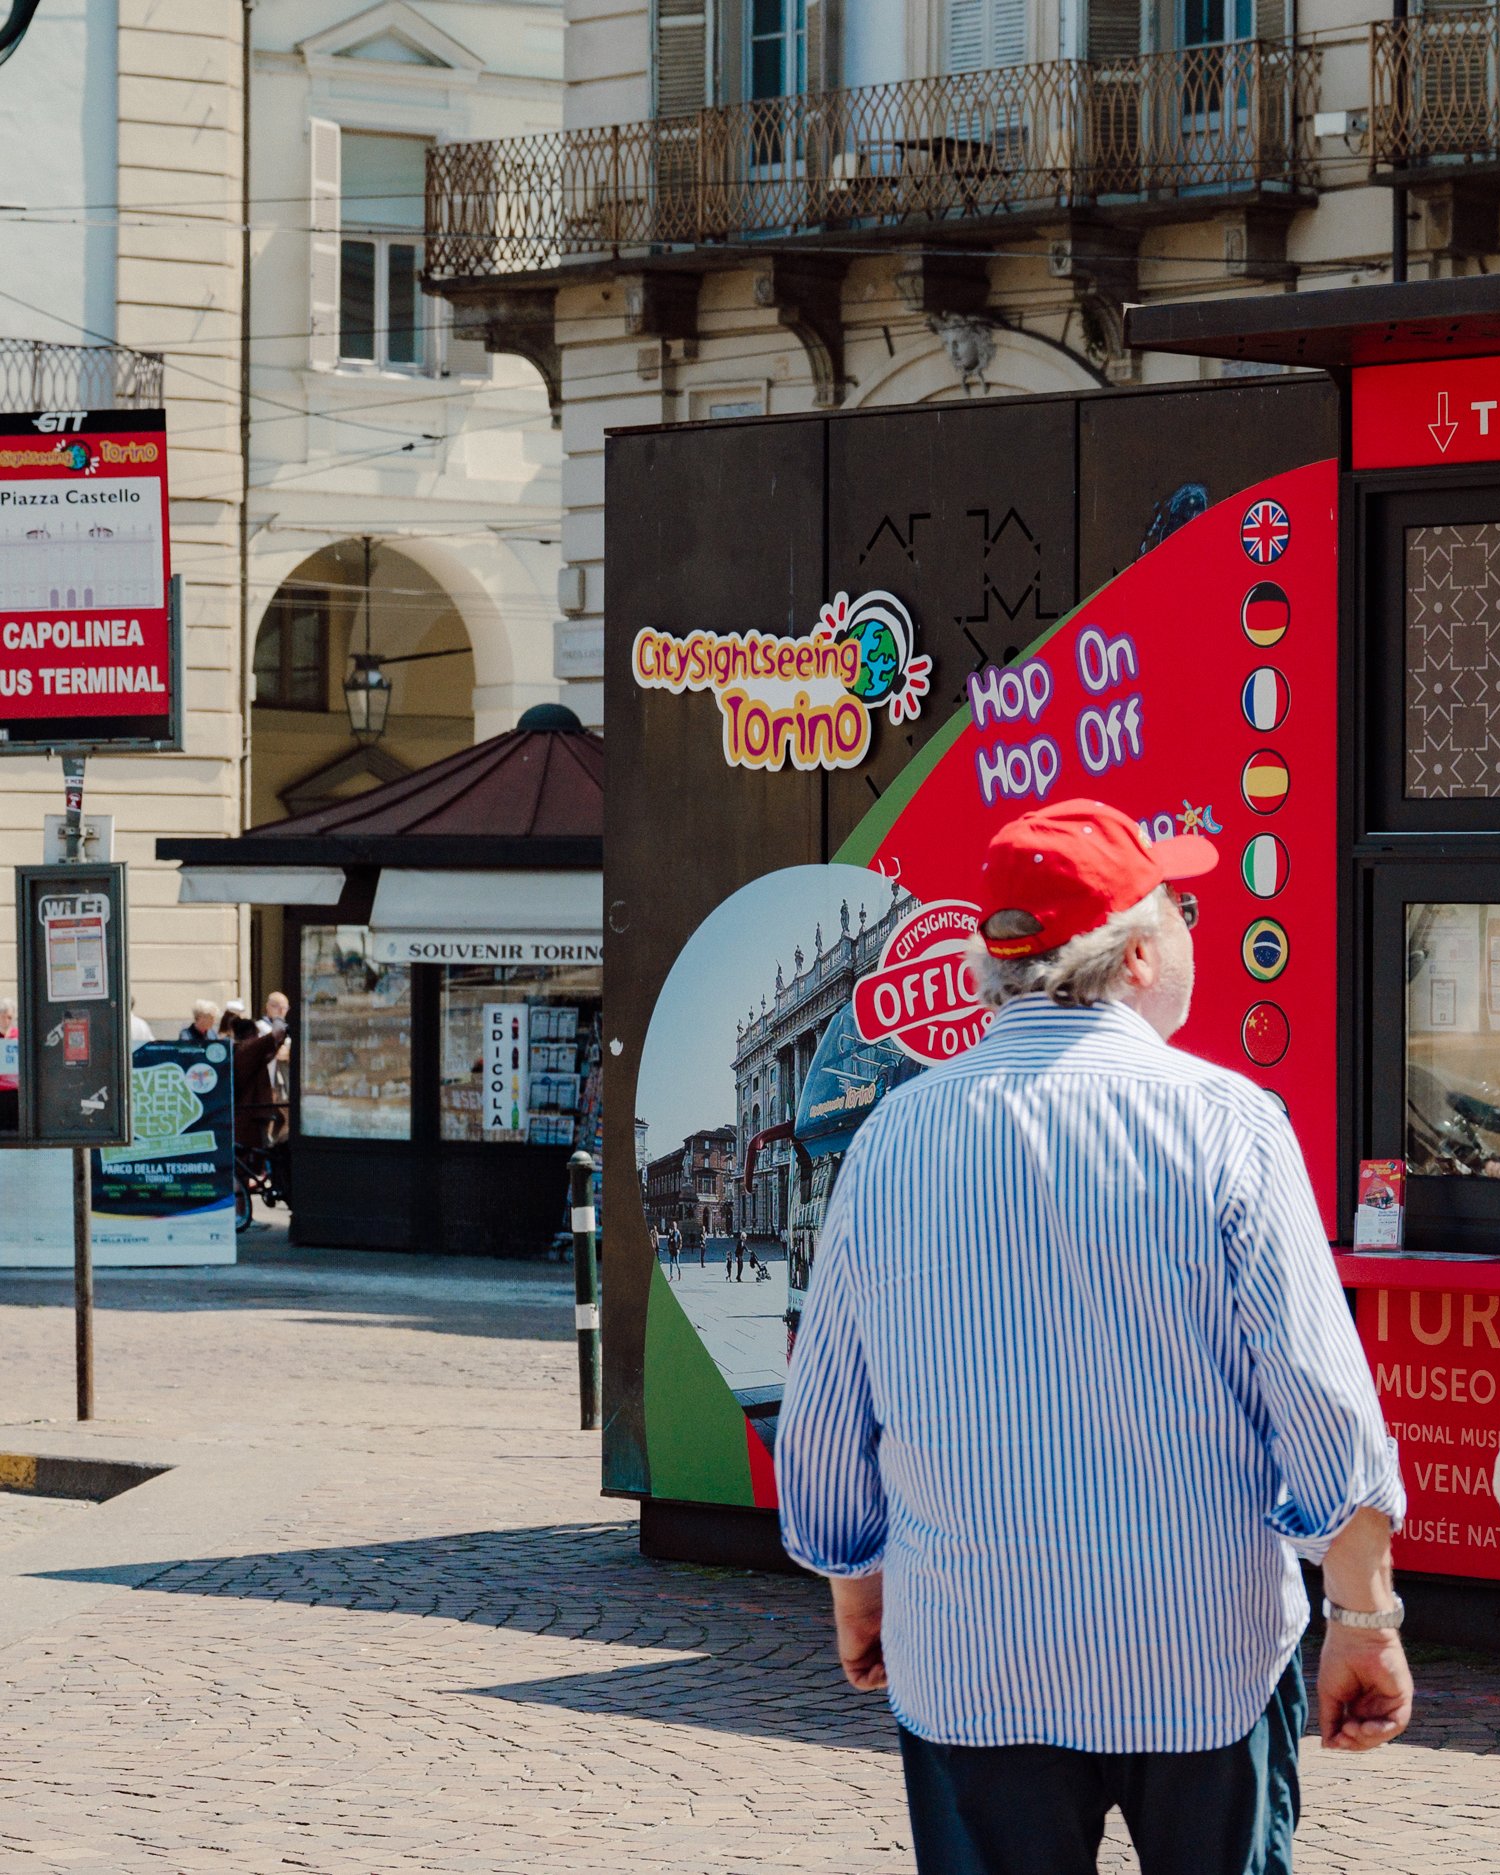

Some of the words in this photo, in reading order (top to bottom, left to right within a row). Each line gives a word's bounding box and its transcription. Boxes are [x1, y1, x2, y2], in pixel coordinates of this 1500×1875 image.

[32, 411, 88, 433] GTT
[100, 441, 158, 463] Torino
[1, 491, 59, 506] Piazza
[65, 488, 140, 504] Castello
[3, 619, 145, 649] CAPOLINEA
[1077, 628, 1137, 692] On
[38, 665, 166, 695] TERMINAL
[726, 694, 863, 759] Torino
[1078, 697, 1141, 773] Off
[409, 943, 524, 959] SOUVENIR
[491, 1012, 504, 1127] EDICOLA
[134, 1163, 164, 1174] DELLA
[165, 1162, 216, 1174] TESORIERA
[1375, 1362, 1497, 1405] MUSEO
[1414, 1461, 1492, 1497] VENA
